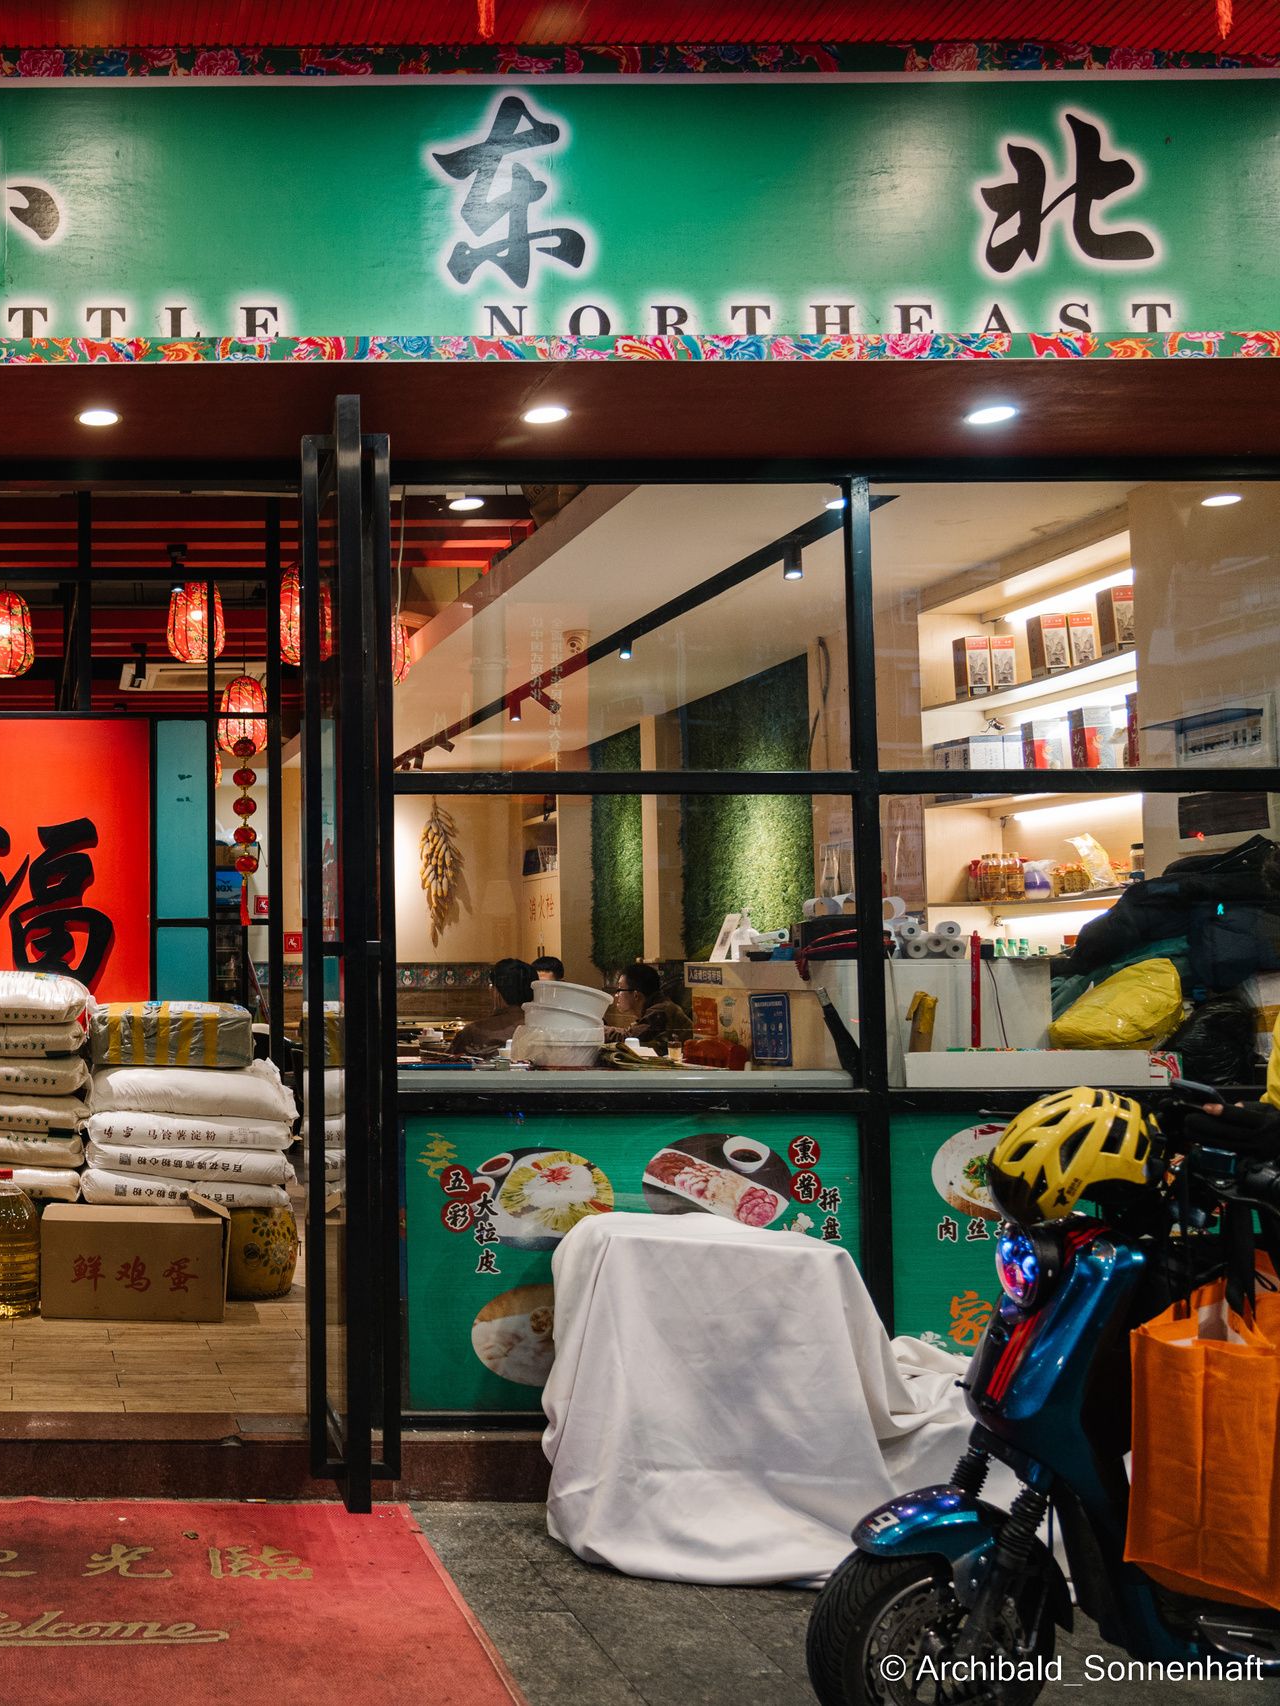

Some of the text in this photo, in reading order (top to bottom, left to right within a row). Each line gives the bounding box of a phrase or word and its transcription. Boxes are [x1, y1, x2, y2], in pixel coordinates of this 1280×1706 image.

[483, 303, 1173, 335] NORTHEAST
[147, 1129, 217, 1142] 马铃薯淀粉
[131, 1188, 235, 1203] 百合花高筋粉心粉
[443, 1170, 472, 1229] 五彩
[817, 1187, 842, 1241] 拼盘
[473, 1192, 502, 1275] 大拉皮
[70, 1255, 200, 1294] 鲜鸡蛋
